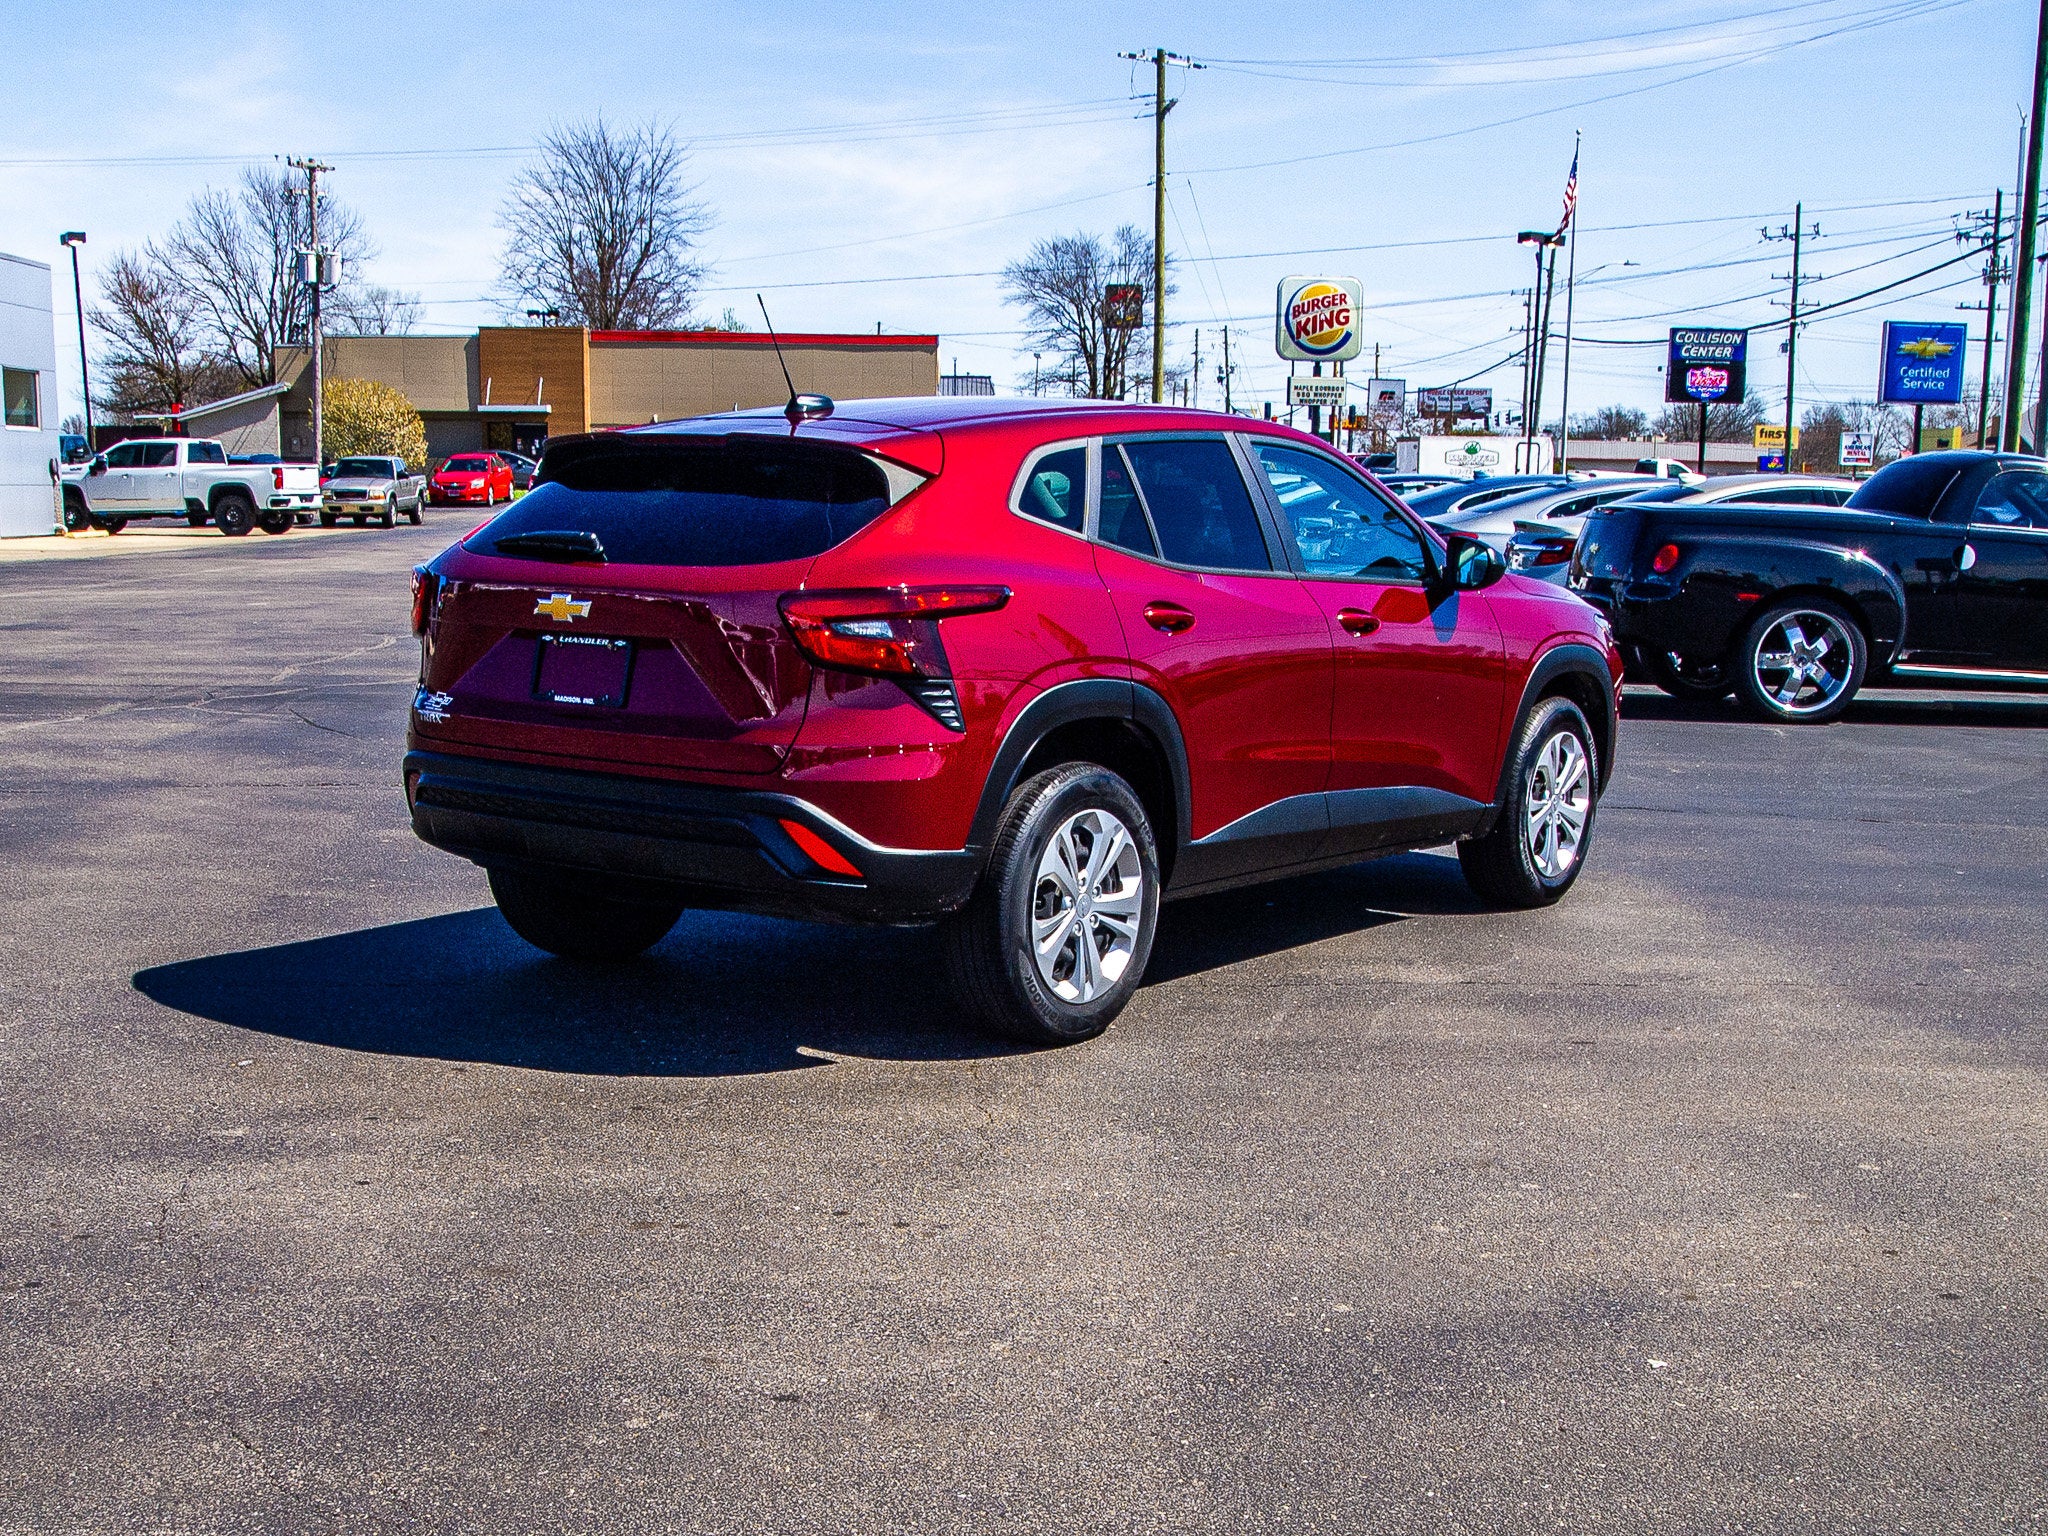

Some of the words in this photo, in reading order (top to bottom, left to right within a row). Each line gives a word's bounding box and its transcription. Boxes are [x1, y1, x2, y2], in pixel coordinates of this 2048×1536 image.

[1292, 293, 1348, 320] BURGER
[1295, 308, 1350, 340] KING
[1675, 331, 1742, 344] COLLISION
[1681, 344, 1732, 358] CENTER
[1900, 366, 1950, 379] Certified
[1903, 378, 1945, 390] Service
[559, 635, 610, 646] CHANDLER
